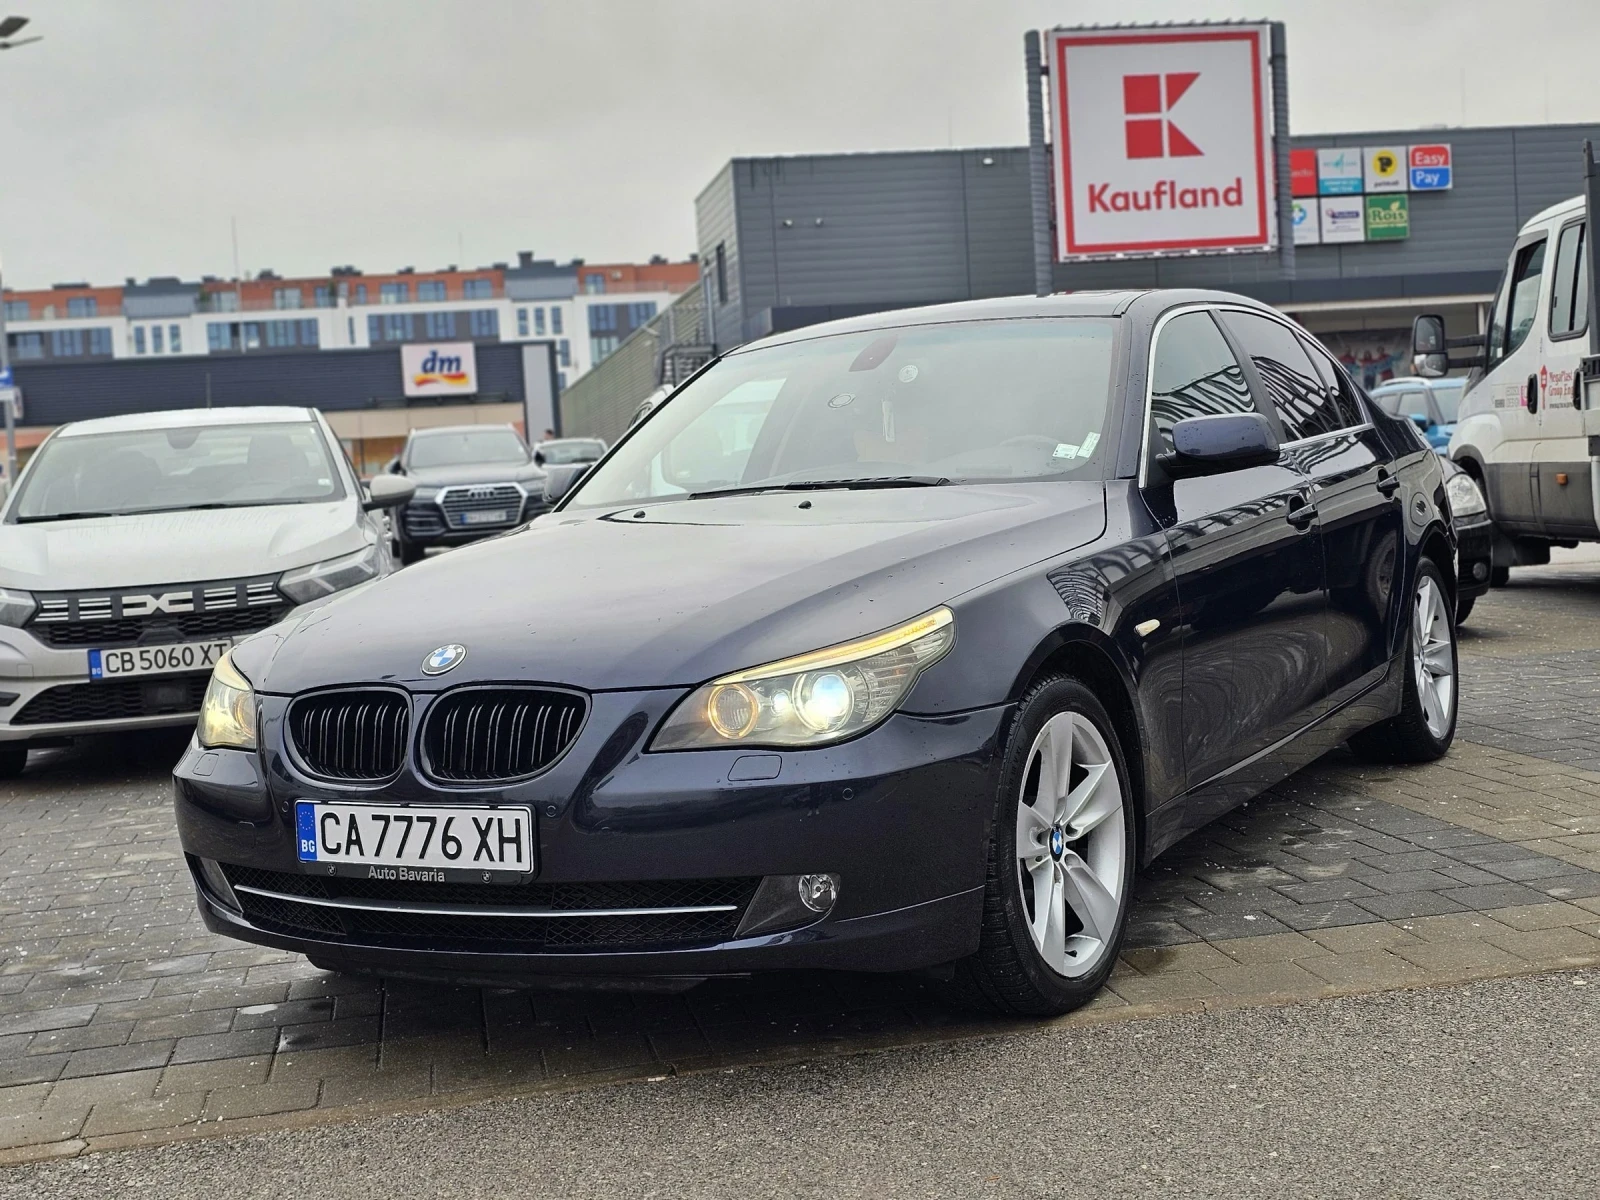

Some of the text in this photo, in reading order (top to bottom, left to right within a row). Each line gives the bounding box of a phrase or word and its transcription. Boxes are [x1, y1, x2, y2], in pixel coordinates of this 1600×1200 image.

[1415, 151, 1446, 166] Easy
[1415, 170, 1440, 186] Pay
[1088, 177, 1243, 213] Kaufland
[421, 350, 462, 373] dm
[105, 650, 135, 673] CB
[140, 647, 195, 671] 5060
[200, 643, 228, 666] XT
[301, 812, 523, 863] BG CA 7776 XH
[368, 865, 445, 882] Auto Bavaria
